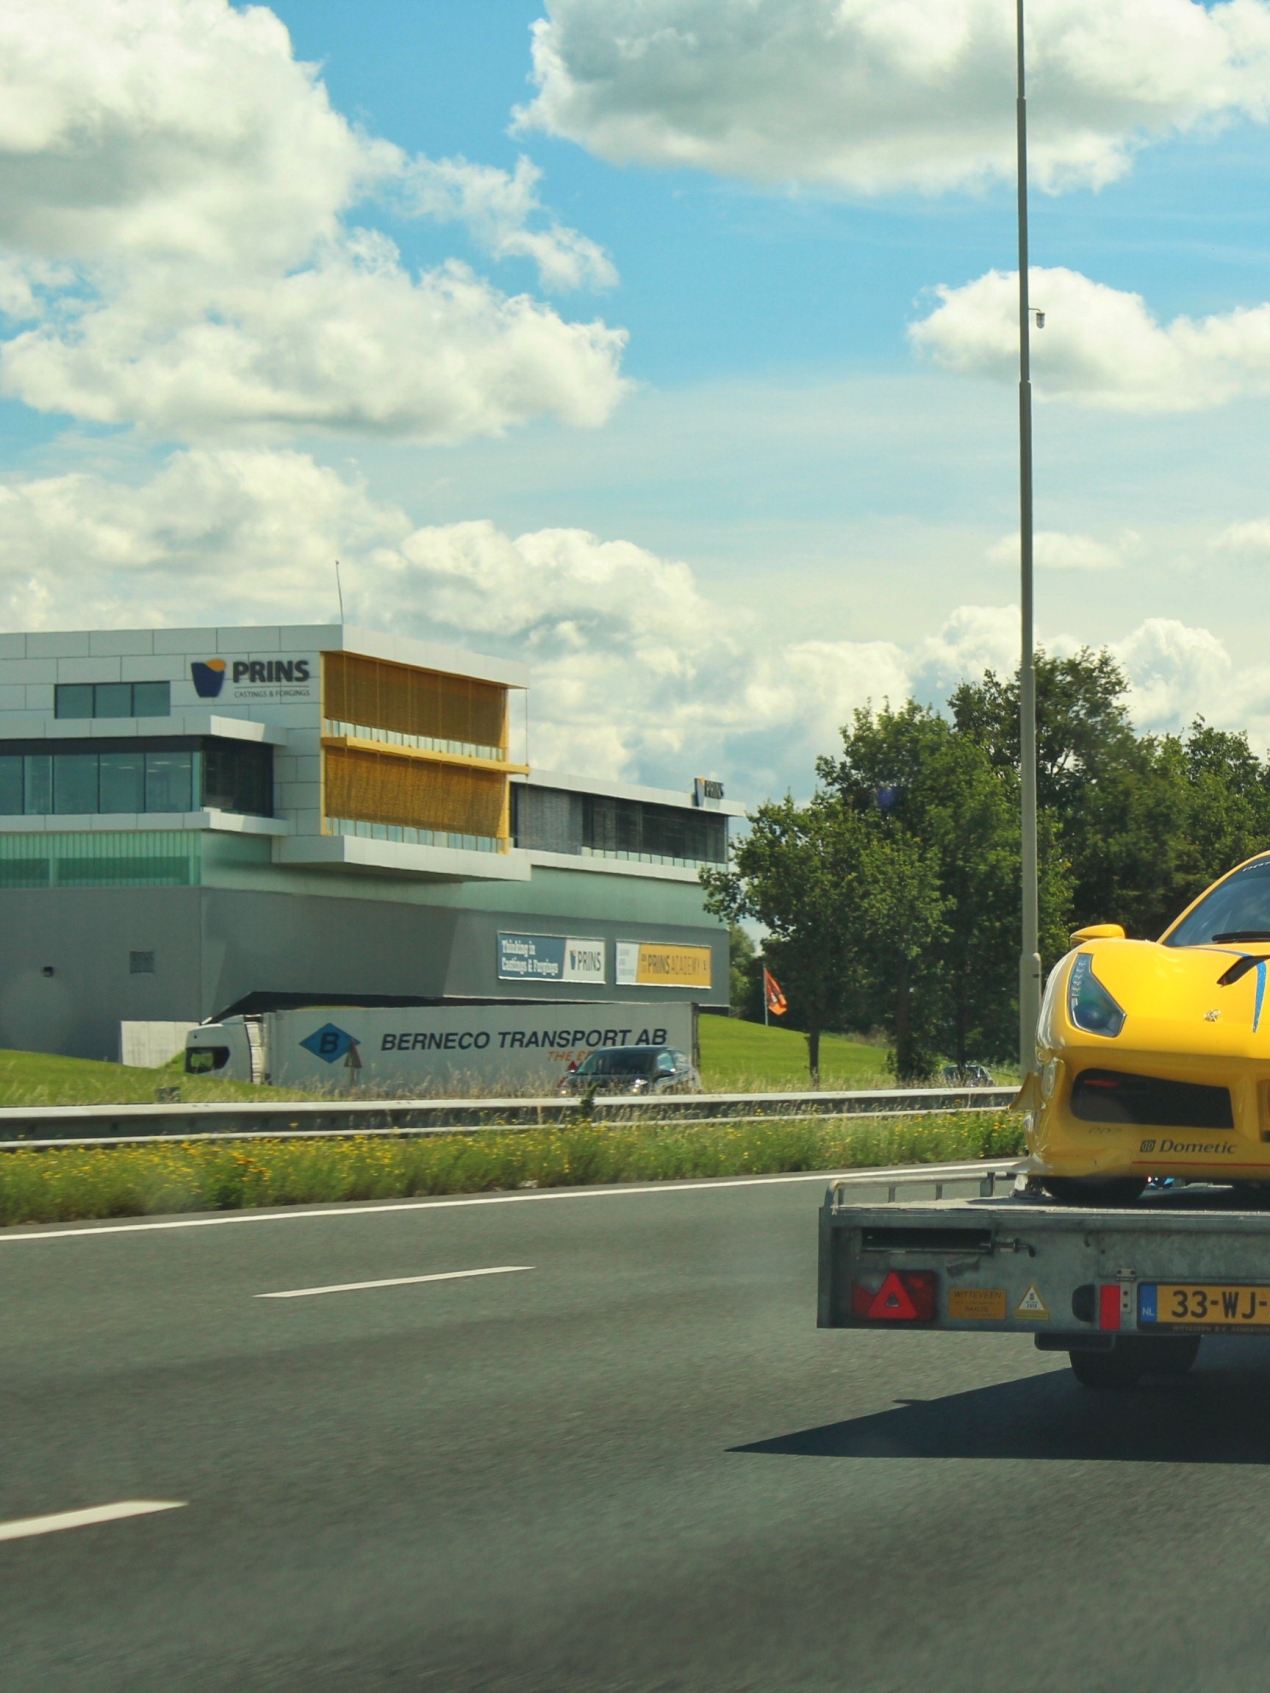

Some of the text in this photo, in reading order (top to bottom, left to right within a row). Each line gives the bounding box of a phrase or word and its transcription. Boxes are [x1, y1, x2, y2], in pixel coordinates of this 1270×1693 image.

[232, 660, 311, 683] PRINS
[234, 690, 268, 698] CASTINGS
[275, 689, 311, 697] FORGINGS
[502, 939, 536, 958] Thinking in
[502, 956, 558, 976] Castings & Forgings
[577, 950, 602, 972] PRINS
[647, 953, 670, 975] PRINS
[319, 1032, 340, 1053] B
[381, 1028, 668, 1051] BERNECO TRANSPORT AB
[548, 1051, 574, 1062] THE
[1159, 1140, 1238, 1154] Dometic
[954, 1290, 1002, 1299] WITTEVEEN
[1142, 1307, 1155, 1316] NL
[1172, 1325, 1212, 1333] WITTEVEEN
